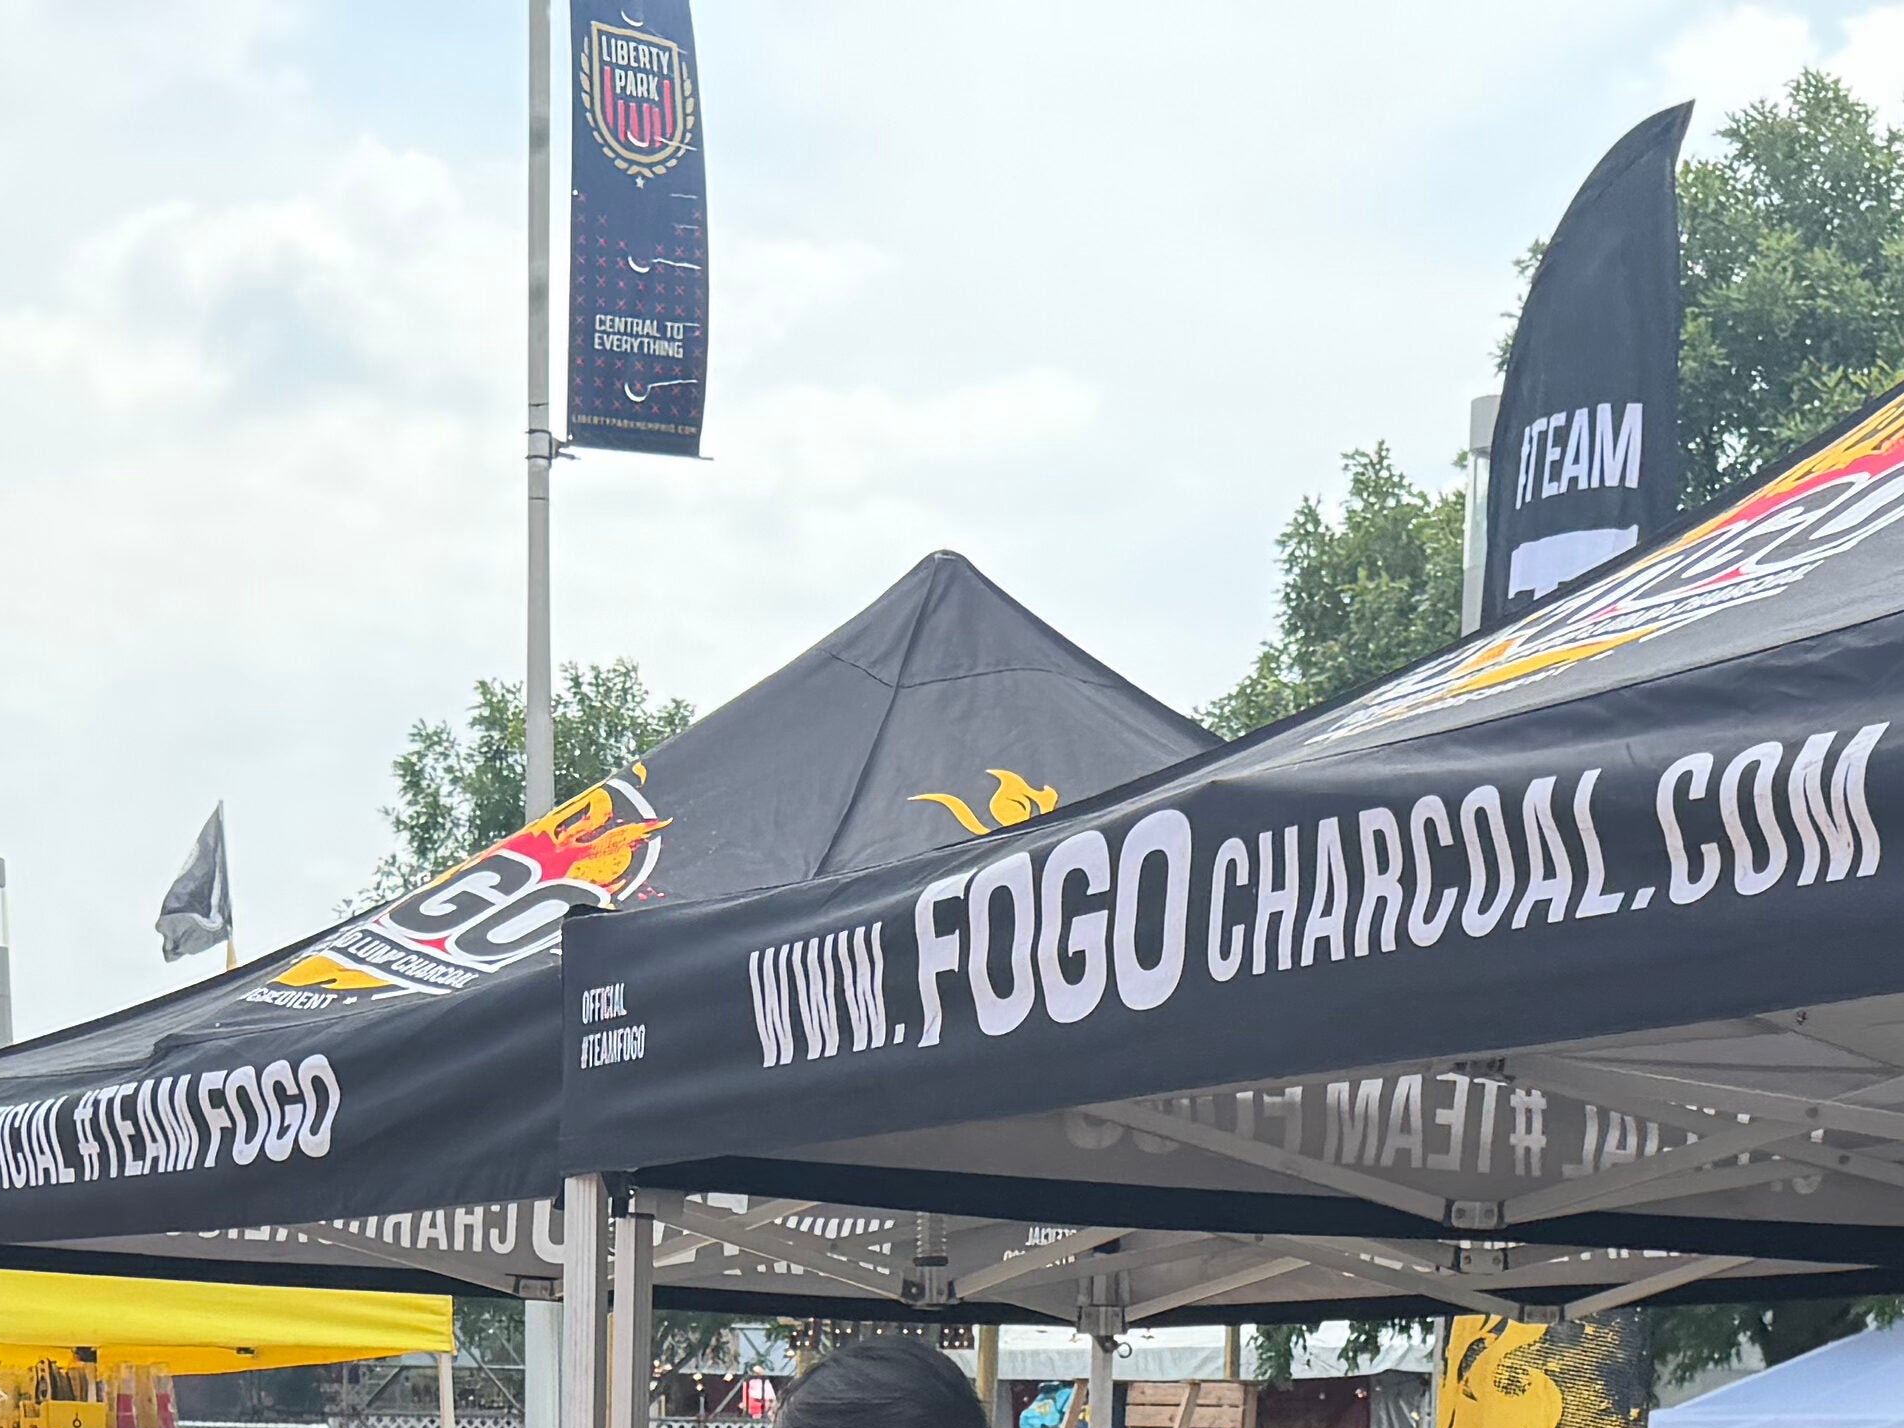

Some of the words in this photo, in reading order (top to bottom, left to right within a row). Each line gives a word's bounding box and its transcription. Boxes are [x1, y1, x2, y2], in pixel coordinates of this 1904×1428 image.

[601, 35, 670, 75] LIBERTY
[615, 69, 659, 101] PARK
[595, 315, 661, 338] CENTRAL
[665, 320, 684, 339] TO
[594, 333, 684, 358] EVERYTHING
[582, 983, 627, 1024] OFFICIAL
[74, 1074, 200, 1181] #TEAM
[199, 1054, 341, 1168] FOGO
